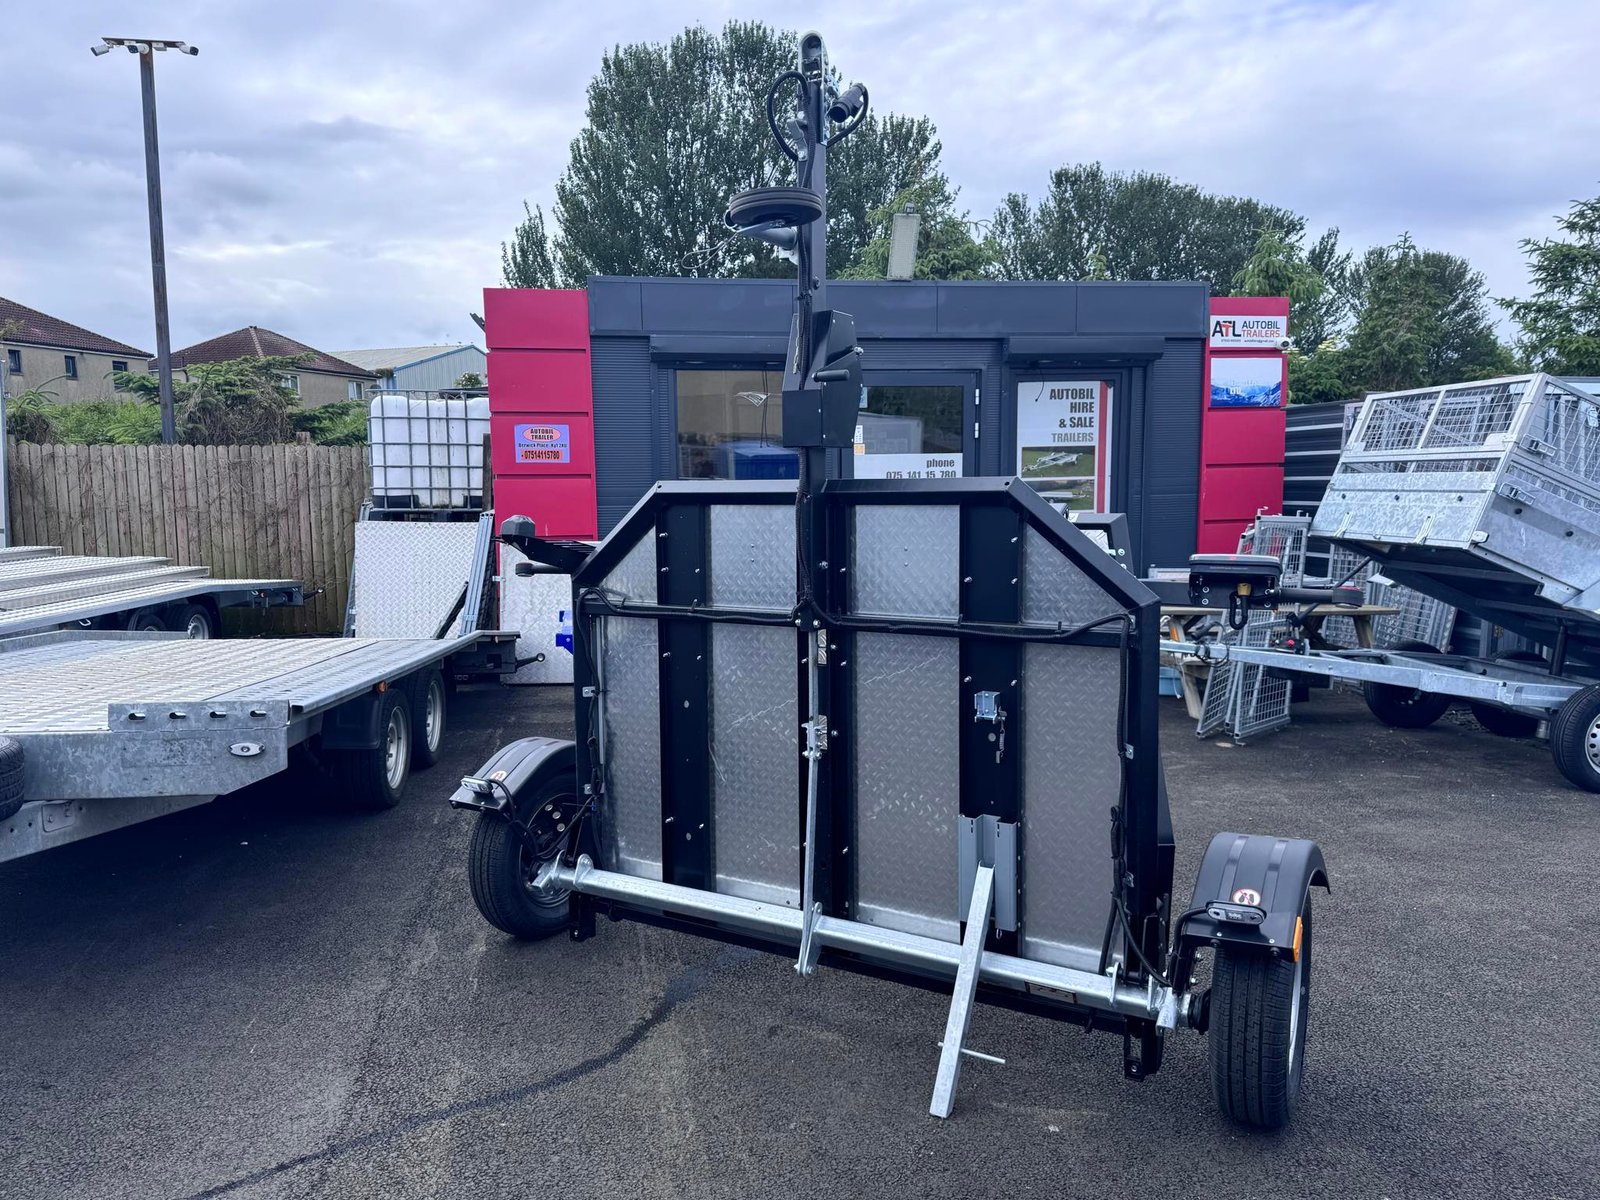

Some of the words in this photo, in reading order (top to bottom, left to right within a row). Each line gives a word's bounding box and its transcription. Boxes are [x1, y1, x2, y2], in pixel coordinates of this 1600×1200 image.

[1242, 320, 1280, 329] AUTOBIL
[1242, 329, 1280, 338] TRAILERS
[1049, 388, 1095, 400] AUTOBIL
[1070, 401, 1094, 413] HIRE
[1058, 418, 1067, 428] &
[1069, 416, 1094, 428] SALE
[1051, 432, 1094, 443] TRAILERS
[926, 459, 955, 468] phone
[886, 471, 903, 479] 075
[907, 471, 921, 479] 141
[925, 470, 936, 478] 15
